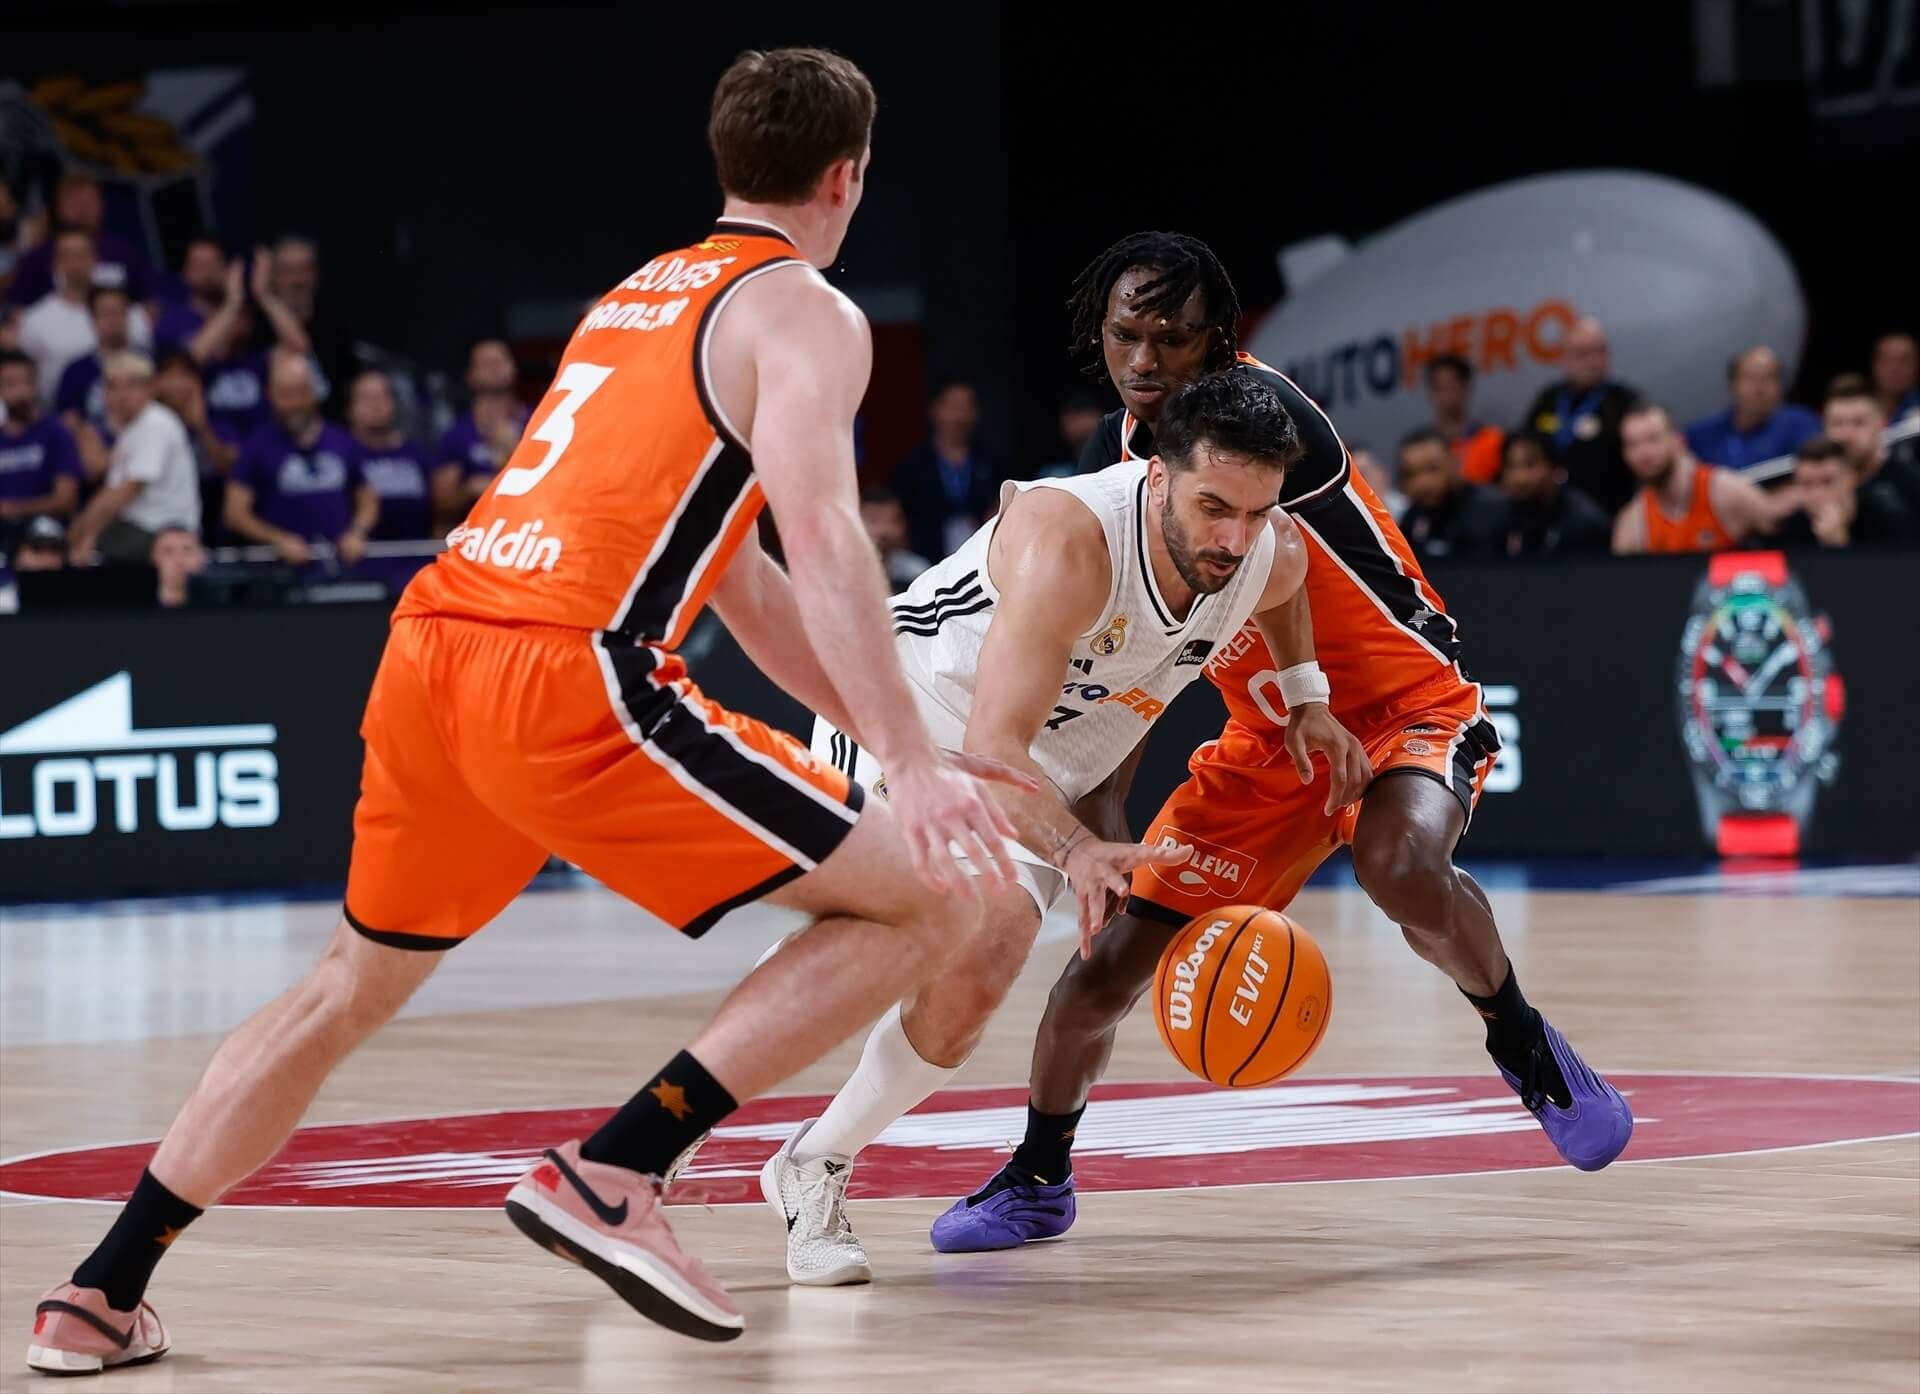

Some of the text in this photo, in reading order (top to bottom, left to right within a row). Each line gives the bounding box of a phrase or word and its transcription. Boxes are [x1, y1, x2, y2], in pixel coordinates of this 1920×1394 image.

[1286, 297, 1580, 402] UTOHERO
[495, 362, 615, 497] 3
[1207, 620, 1260, 678] AREN
[1161, 835, 1240, 883] PLEVA
[1169, 919, 1233, 1031] Wilson
